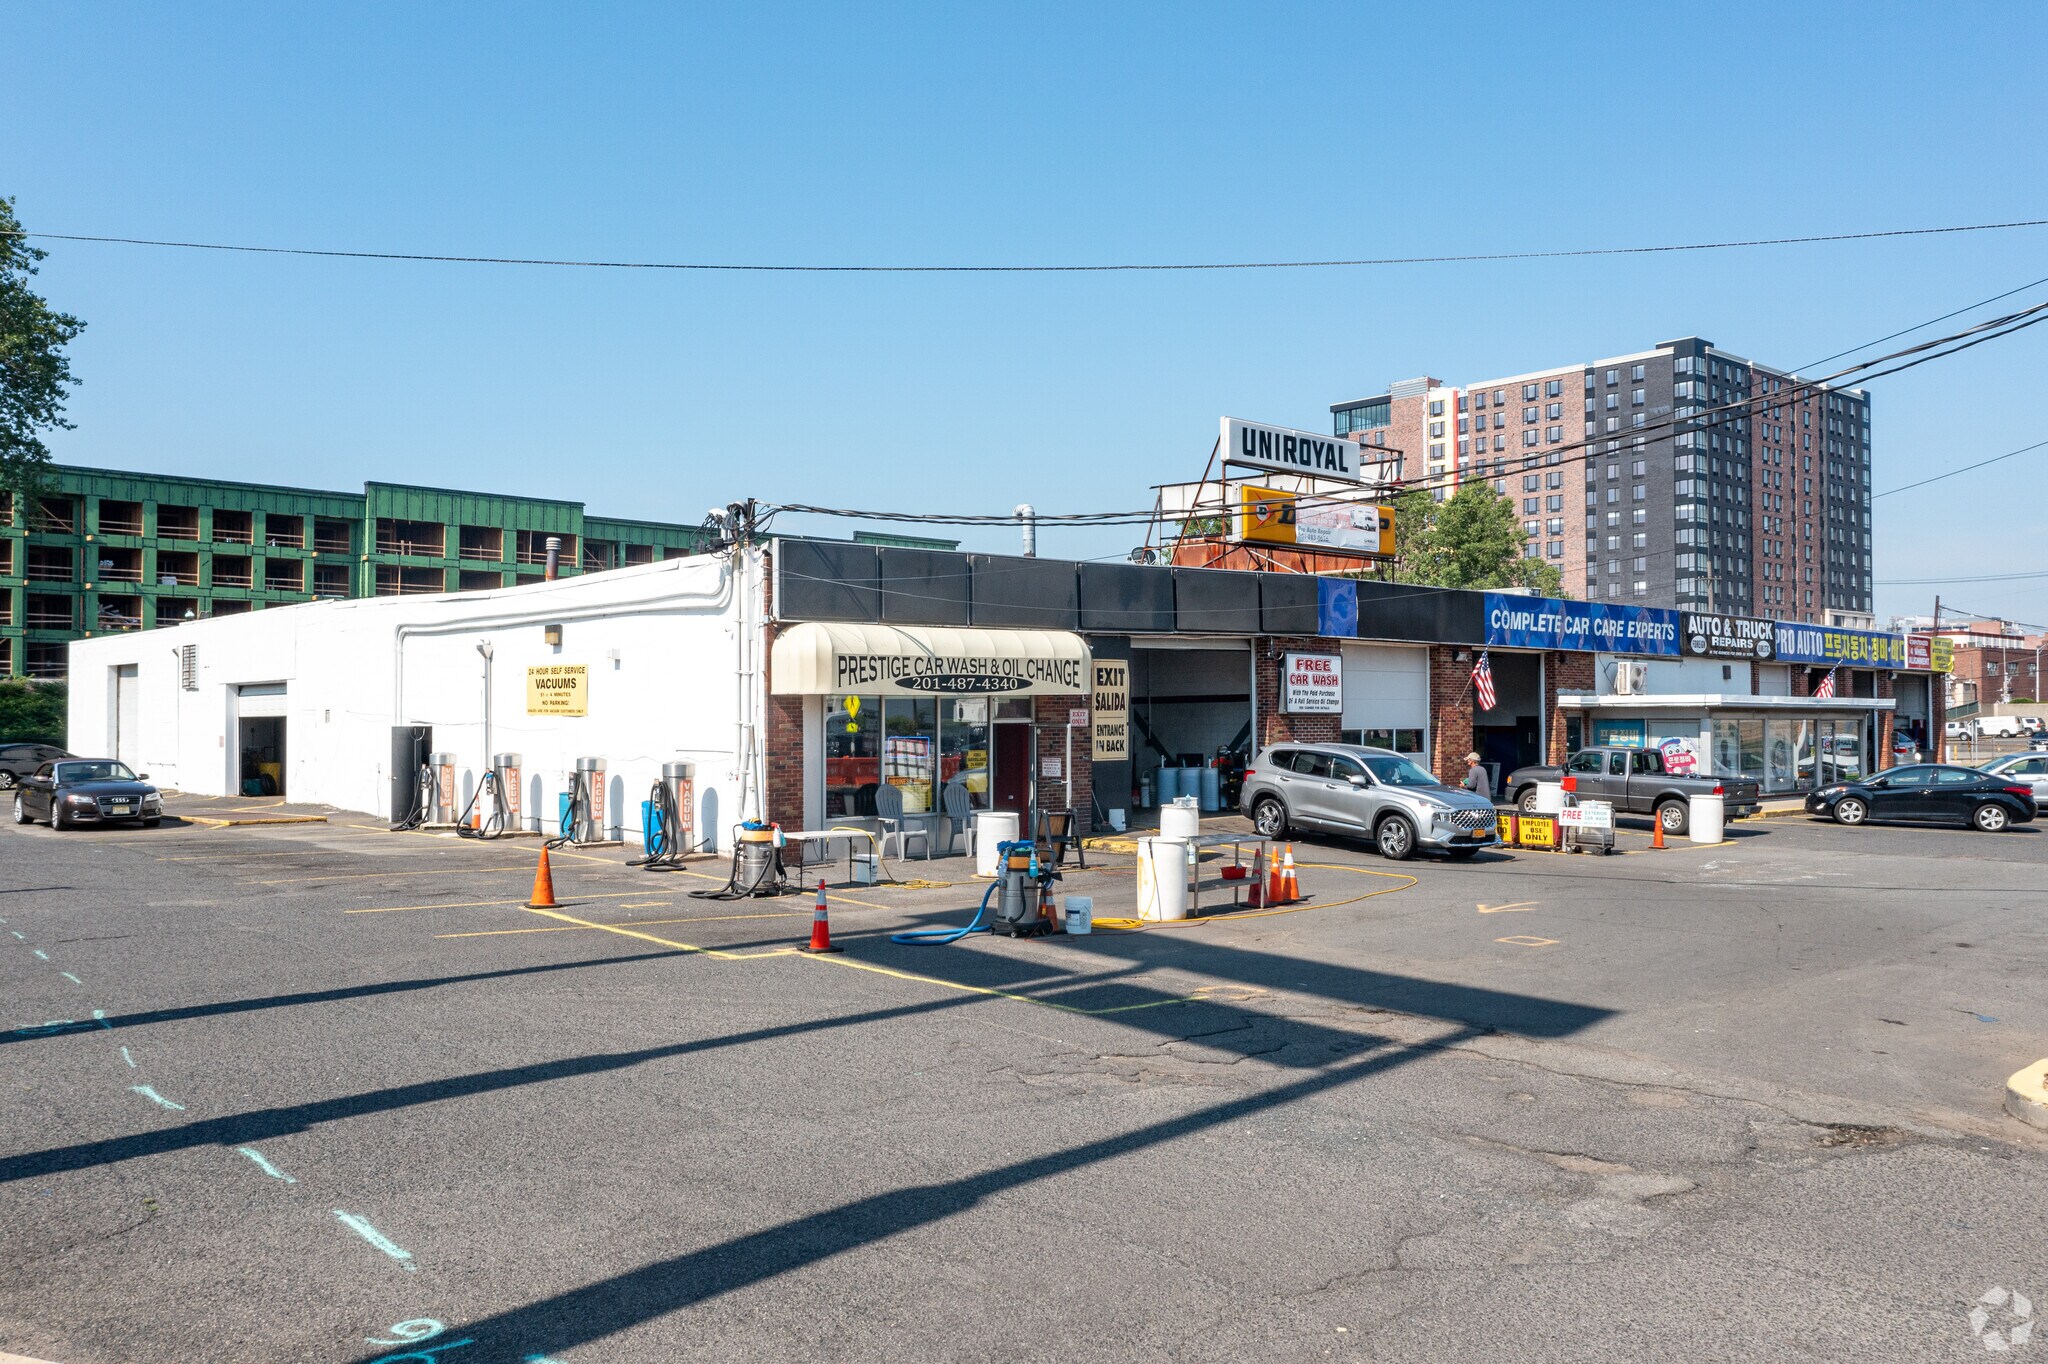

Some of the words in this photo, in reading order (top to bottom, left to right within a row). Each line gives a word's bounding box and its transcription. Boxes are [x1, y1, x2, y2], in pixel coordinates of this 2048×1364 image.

[1242, 427, 1349, 473] UNIROYAL
[1491, 609, 1562, 633] COMPLETE
[1564, 616, 1590, 635] CAR
[1593, 618, 1624, 637] CARE
[1627, 621, 1675, 641] EXPERTS
[1688, 615, 1721, 636] AUTO
[1723, 618, 1732, 637] &
[1735, 620, 1774, 640] TRUCK
[1711, 636, 1754, 649] REPAIRS
[1775, 628, 1796, 655] PRO
[1797, 630, 1823, 657] AUTO
[528, 668, 534, 676] 24
[551, 667, 562, 675] SELF
[564, 666, 586, 674] SERVICE
[838, 655, 911, 688] PRESTIGE
[914, 657, 944, 675] CAR
[947, 658, 987, 674] WASH
[990, 658, 1000, 675] &
[1002, 658, 1024, 678] OIL
[1026, 659, 1081, 689] CHANGE
[1295, 658, 1332, 672] FREE
[535, 677, 577, 689] VACUUMS
[912, 677, 1018, 690] 201-487-4340
[1096, 667, 1125, 687] EXIT
[1289, 673, 1309, 686] CAR
[1312, 674, 1339, 687] WASH
[1095, 692, 1126, 711] SALIDA
[1096, 724, 1125, 736] ENTRANCE
[1600, 729, 1639, 742] 프로정비
[1096, 740, 1105, 752] IN
[1106, 740, 1125, 752] BACK
[1668, 755, 1692, 765] 프로정비
[443, 767, 451, 805] VACUUM
[510, 770, 518, 810] VACUUM
[594, 774, 602, 818] VACUUM
[682, 782, 691, 829] VACUUM
[1562, 810, 1582, 820] FREE
